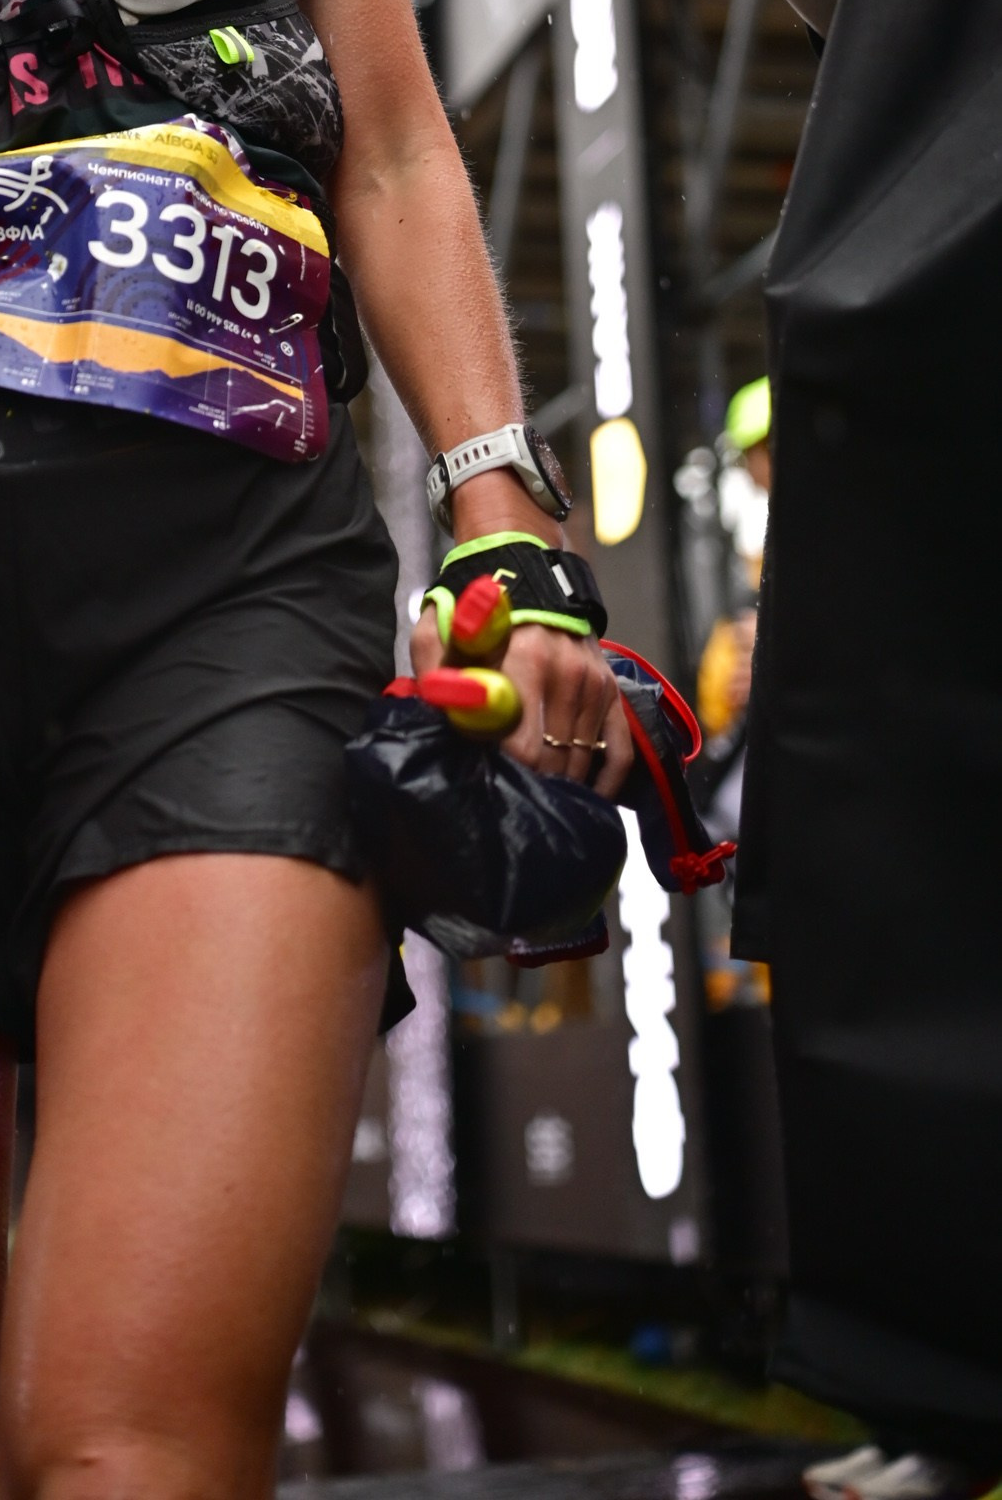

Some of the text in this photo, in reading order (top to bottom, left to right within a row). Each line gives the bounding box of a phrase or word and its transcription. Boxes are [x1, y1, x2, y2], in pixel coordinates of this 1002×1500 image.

[88, 162, 172, 188] Чемпионат
[88, 189, 278, 320] 3313
[194, 303, 206, 317] 00
[206, 310, 222, 326] 444
[223, 319, 241, 335] 925
